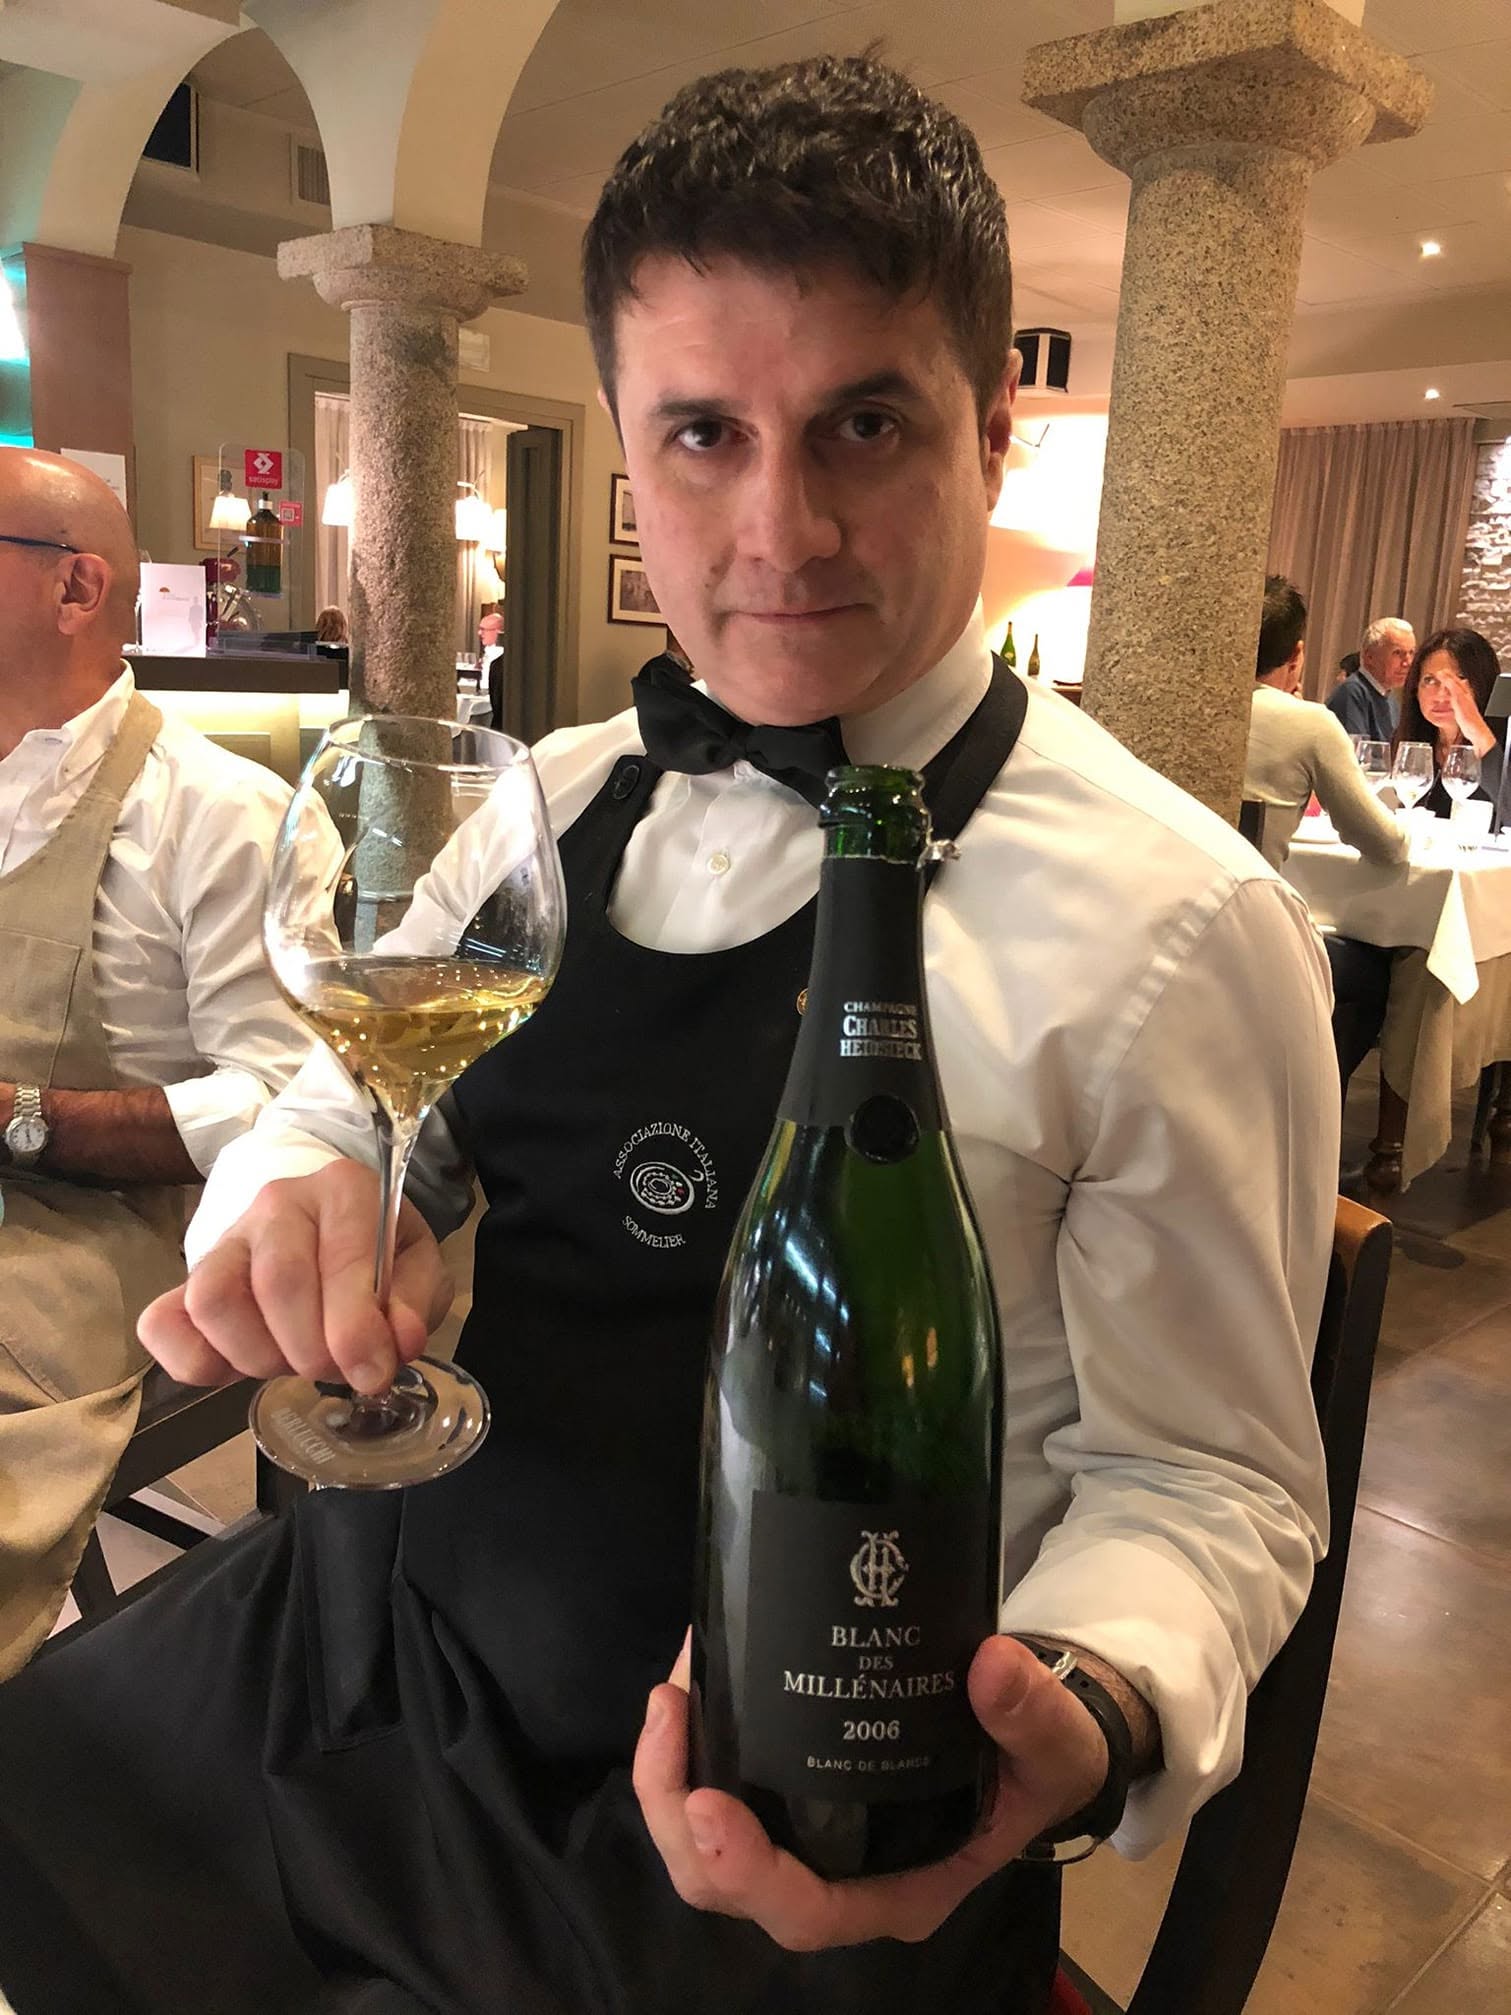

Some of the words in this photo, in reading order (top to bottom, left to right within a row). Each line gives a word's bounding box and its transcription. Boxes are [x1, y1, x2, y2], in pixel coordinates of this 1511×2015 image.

[613, 1121, 691, 1180] ASSOCIAZIONE
[688, 1137, 718, 1209] ITALIANA
[622, 1215, 686, 1249] SOMMELIER
[831, 1625, 921, 1648] BLANC
[859, 1656, 894, 1671] DES
[783, 1670, 955, 1699] MILLÉNAIRES
[843, 1720, 900, 1741] 2006
[807, 1755, 852, 1771] BLANC
[858, 1759, 876, 1771] DE
